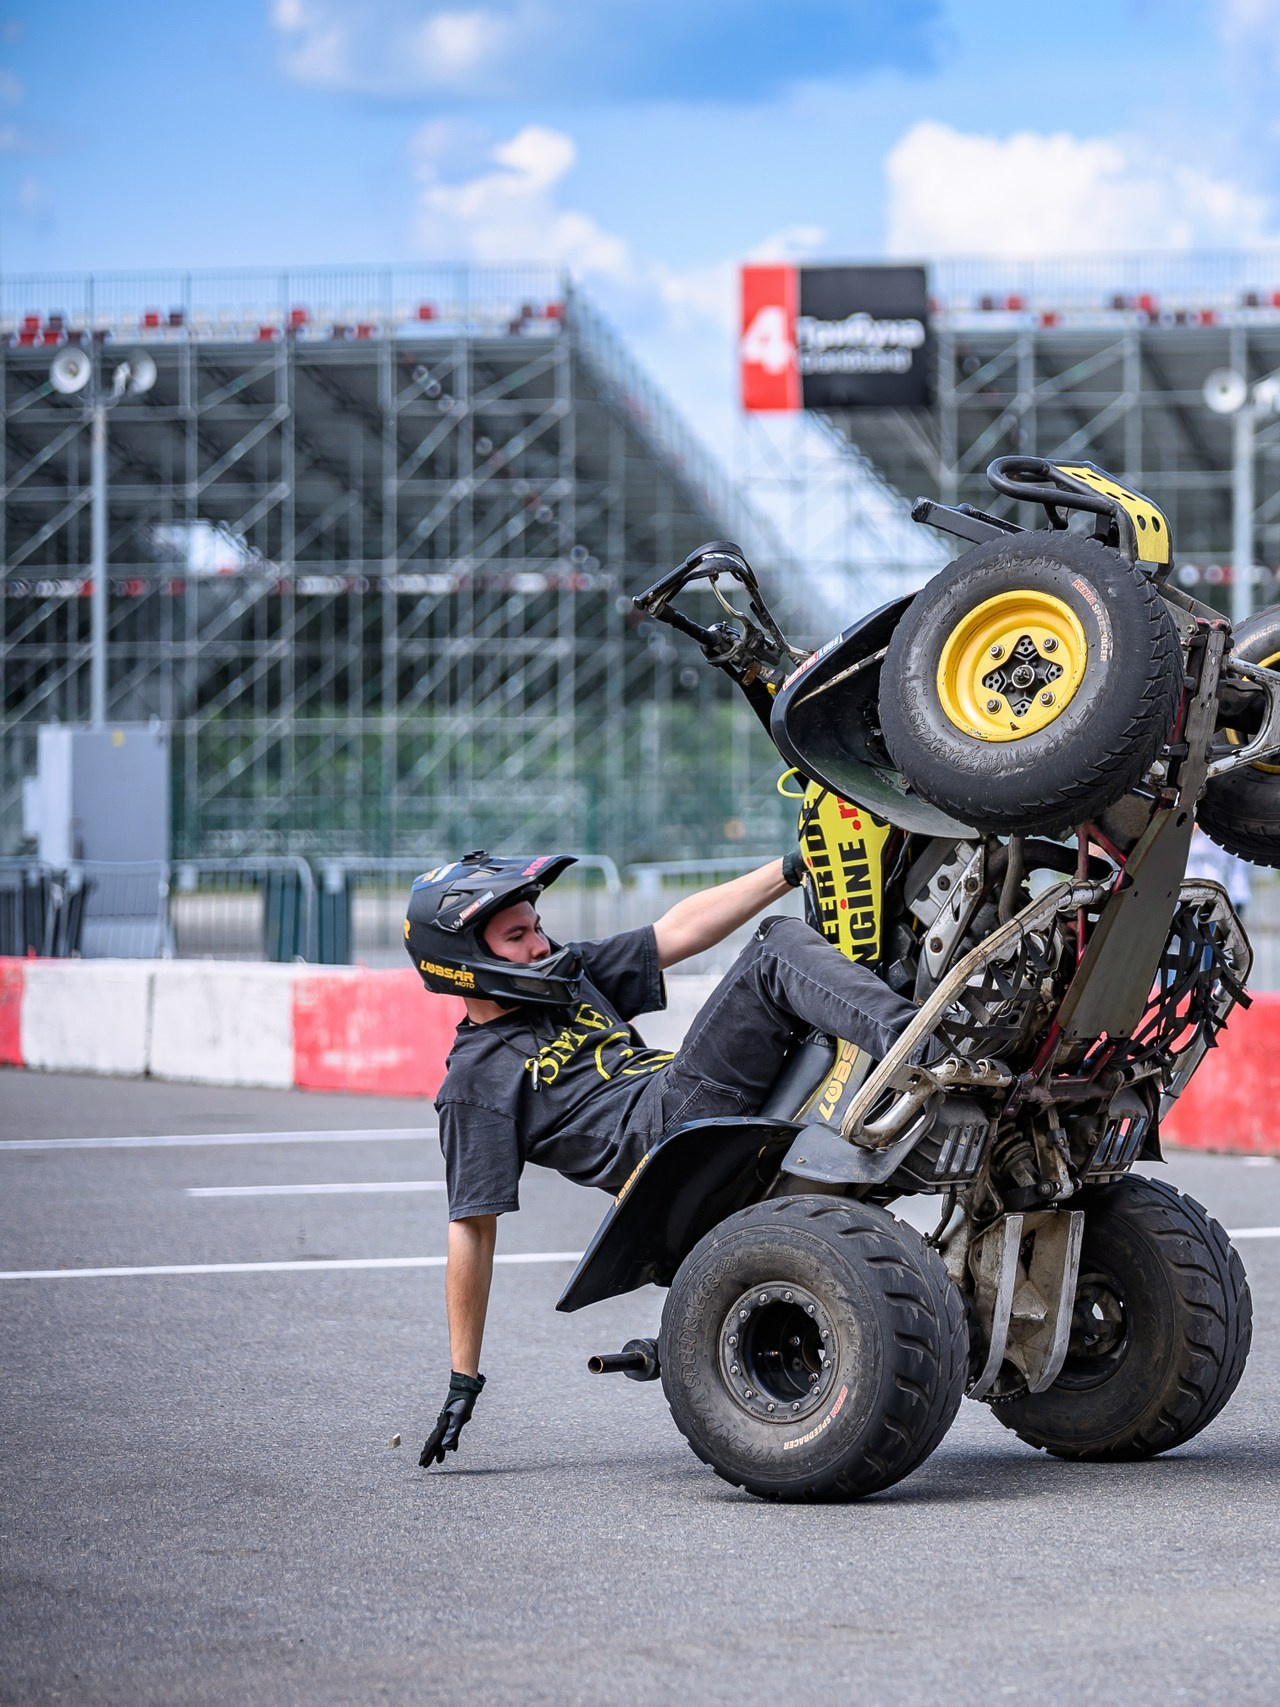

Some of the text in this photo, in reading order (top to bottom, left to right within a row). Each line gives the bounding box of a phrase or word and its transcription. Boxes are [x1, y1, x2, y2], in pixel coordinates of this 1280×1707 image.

[743, 305, 797, 376] 4
[1072, 579, 1108, 662] KENDA SPEERACER
[420, 960, 475, 982] LUBSAR
[455, 980, 475, 989] MOTO
[615, 1153, 649, 1207] LUBSAR
[680, 1272, 720, 1389] SPEEDRACER
[783, 1384, 848, 1450] KENDA SPEEDRACER
